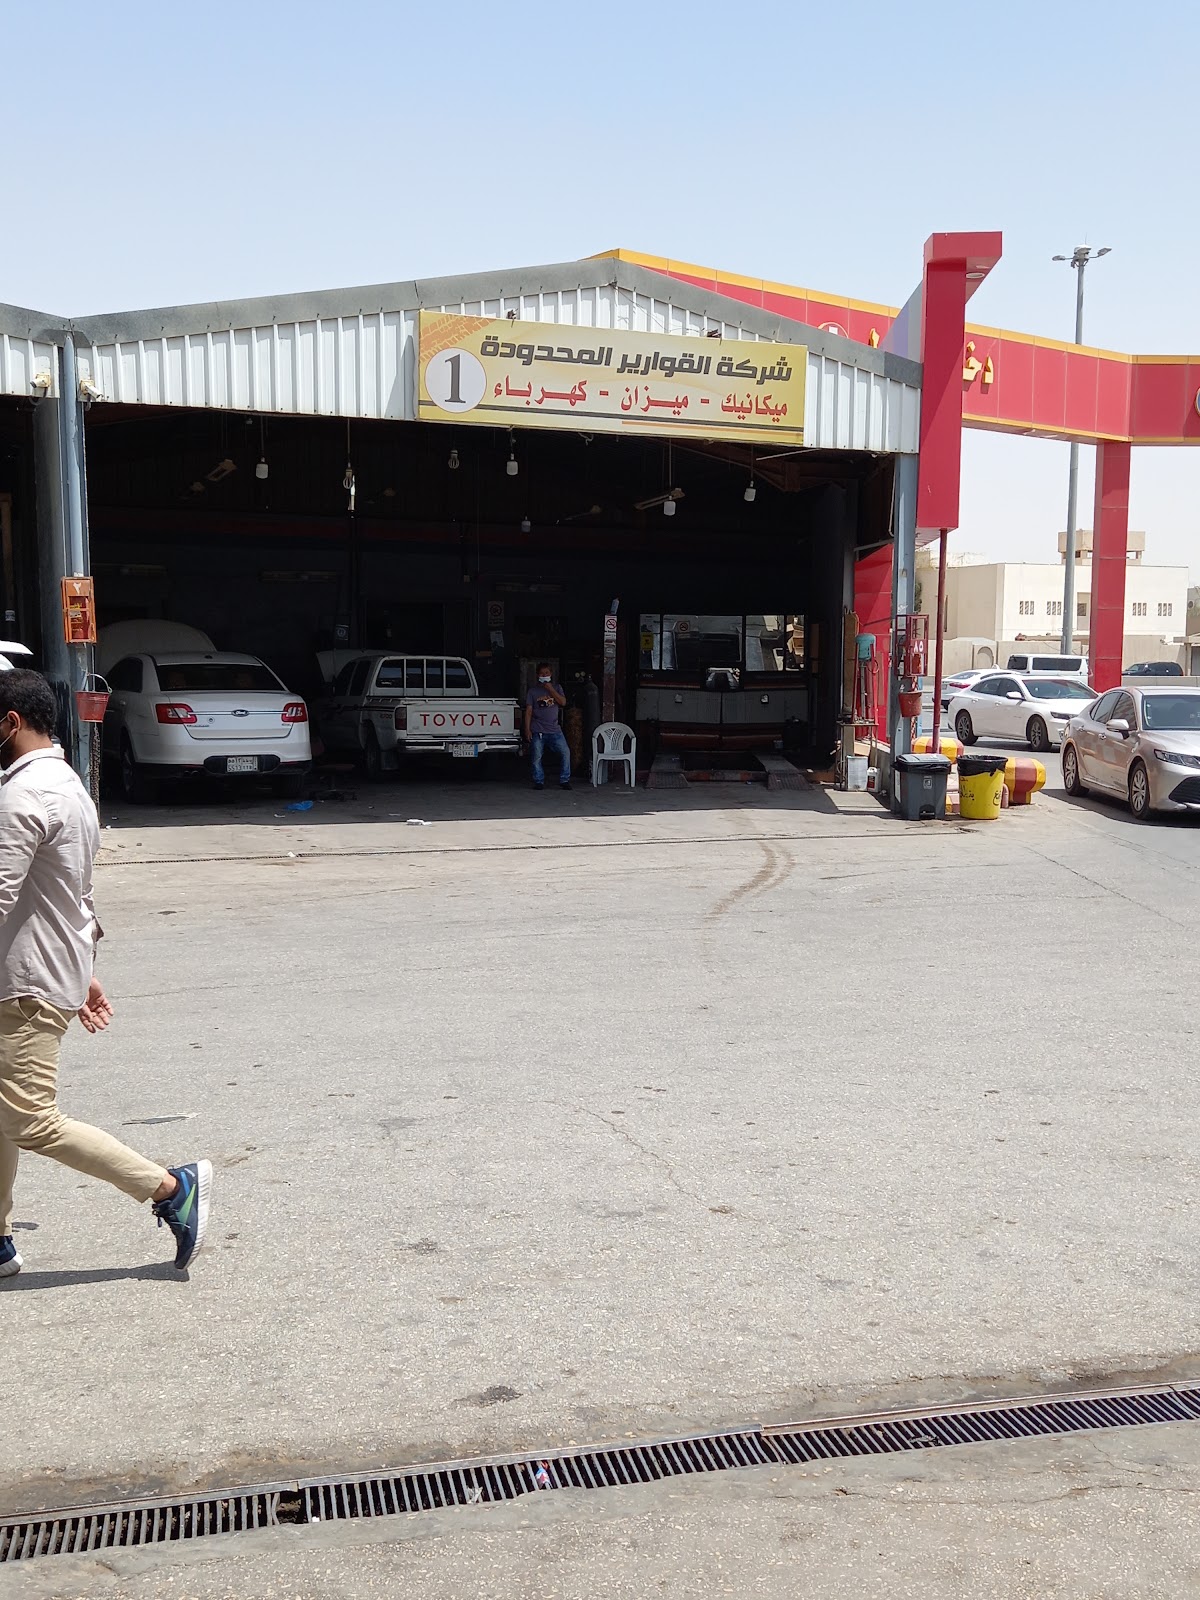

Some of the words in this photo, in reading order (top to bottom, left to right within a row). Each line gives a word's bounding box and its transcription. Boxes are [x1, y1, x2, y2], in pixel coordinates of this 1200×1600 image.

[480, 335, 613, 366] المحدودة
[617, 351, 712, 377] القوارير
[444, 354, 466, 404] 1
[716, 355, 793, 385] شركة
[493, 375, 587, 406] كهرباء
[620, 385, 689, 415] ميزان
[720, 392, 788, 423] ميكانيك
[420, 713, 501, 727] TOYOTA
